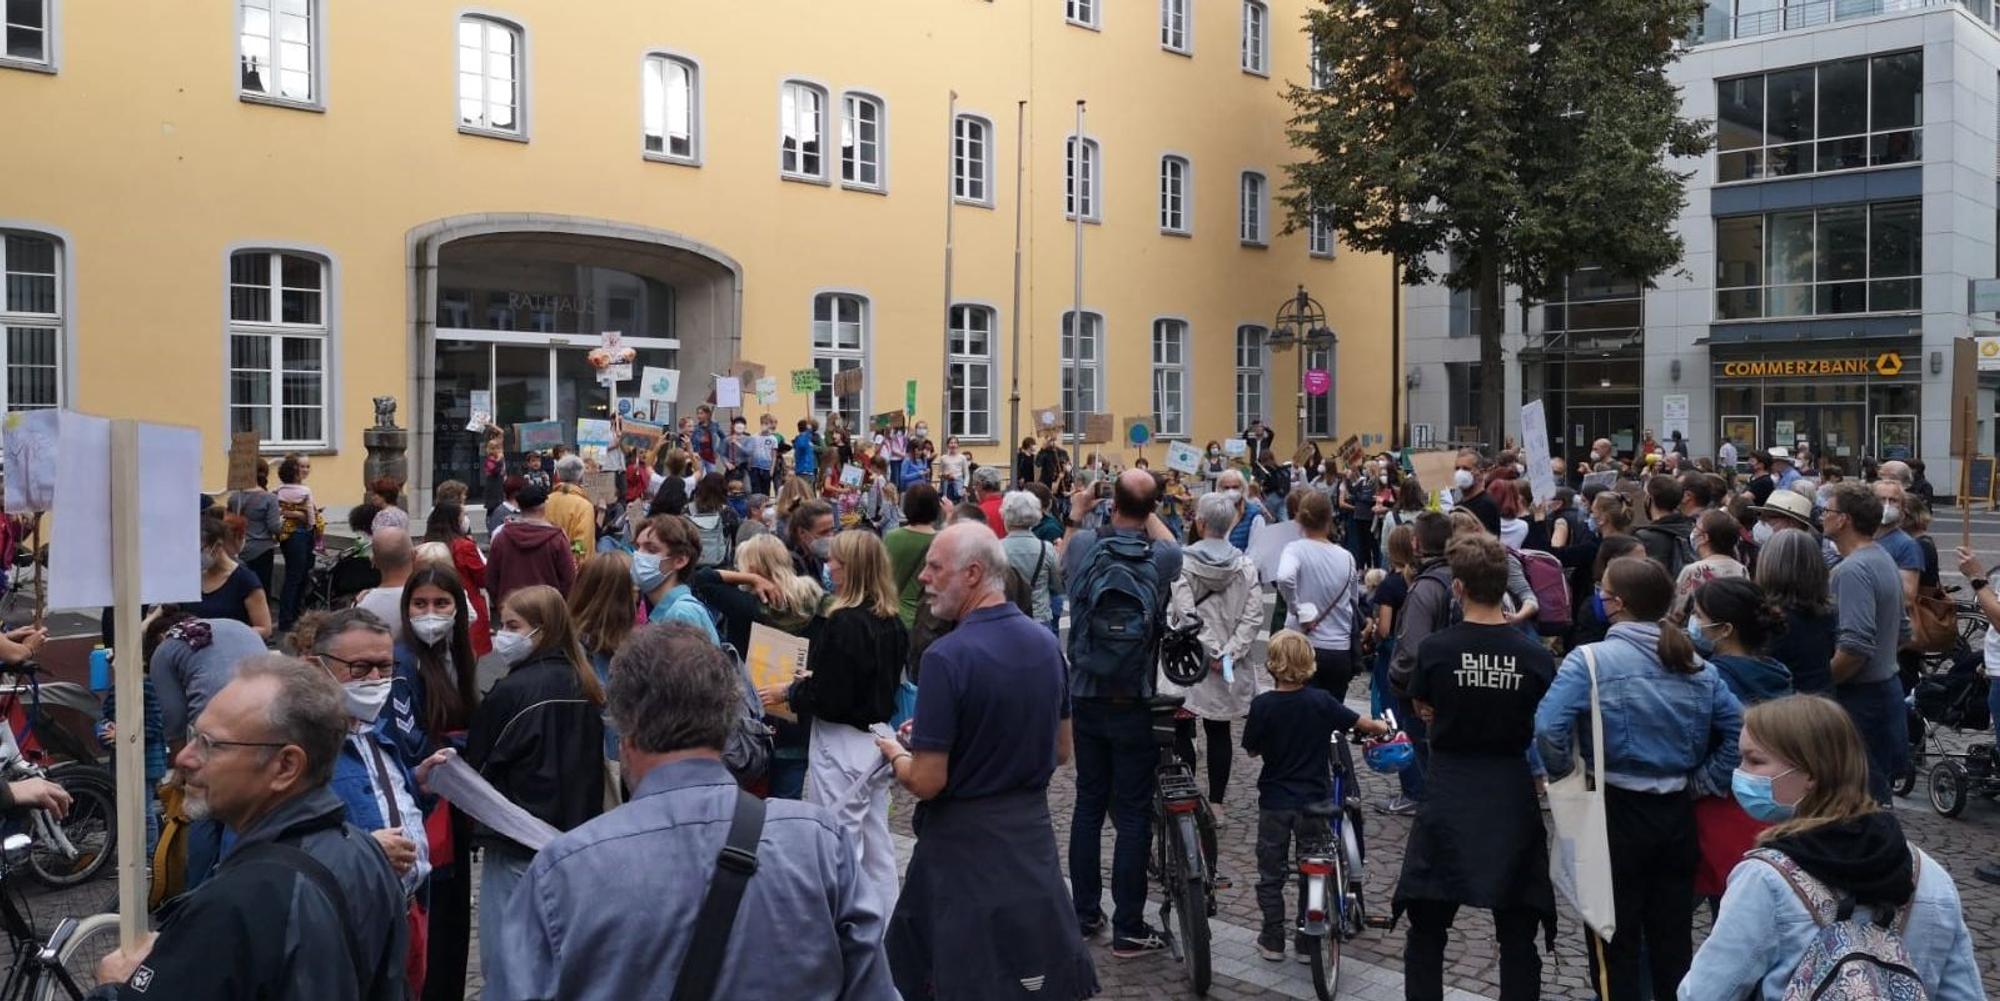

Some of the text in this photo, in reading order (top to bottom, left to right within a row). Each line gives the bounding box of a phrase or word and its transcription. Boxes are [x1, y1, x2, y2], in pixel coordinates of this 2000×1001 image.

[508, 291, 597, 314] RATHAUS
[1724, 359, 1870, 376] COMMERZBANK
[1461, 653, 1516, 672] BILLY
[1453, 670, 1523, 691] TALENT
